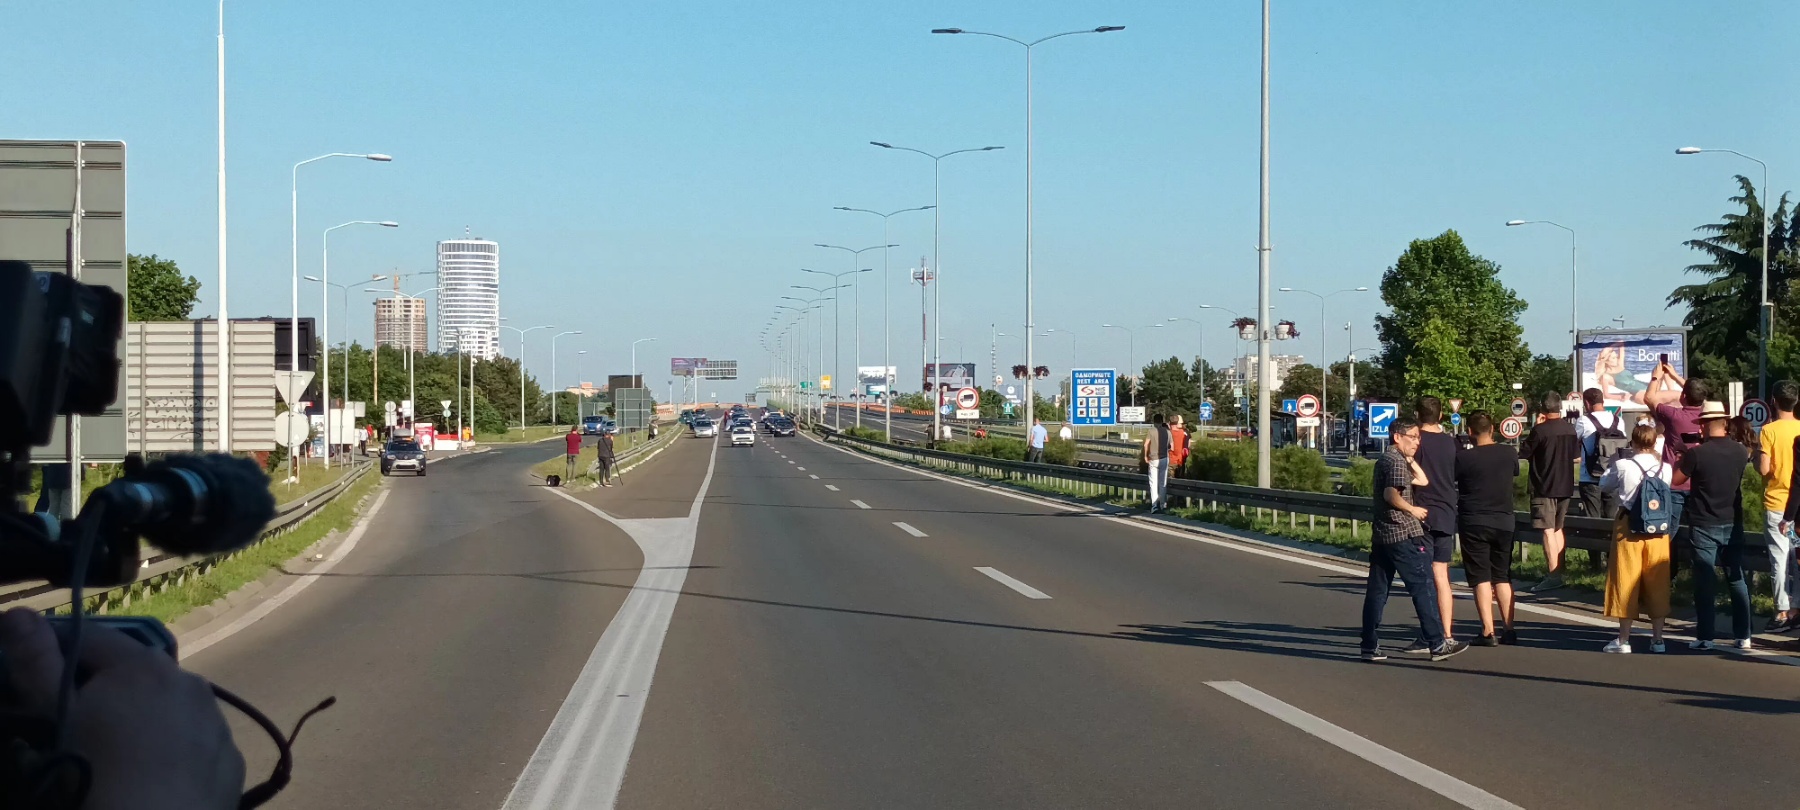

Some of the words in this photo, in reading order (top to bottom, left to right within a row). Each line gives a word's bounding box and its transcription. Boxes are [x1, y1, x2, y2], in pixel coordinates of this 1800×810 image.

[1638, 348, 1680, 361] Bontti
[1746, 406, 1764, 422] 50
[1504, 422, 1518, 434] 40
